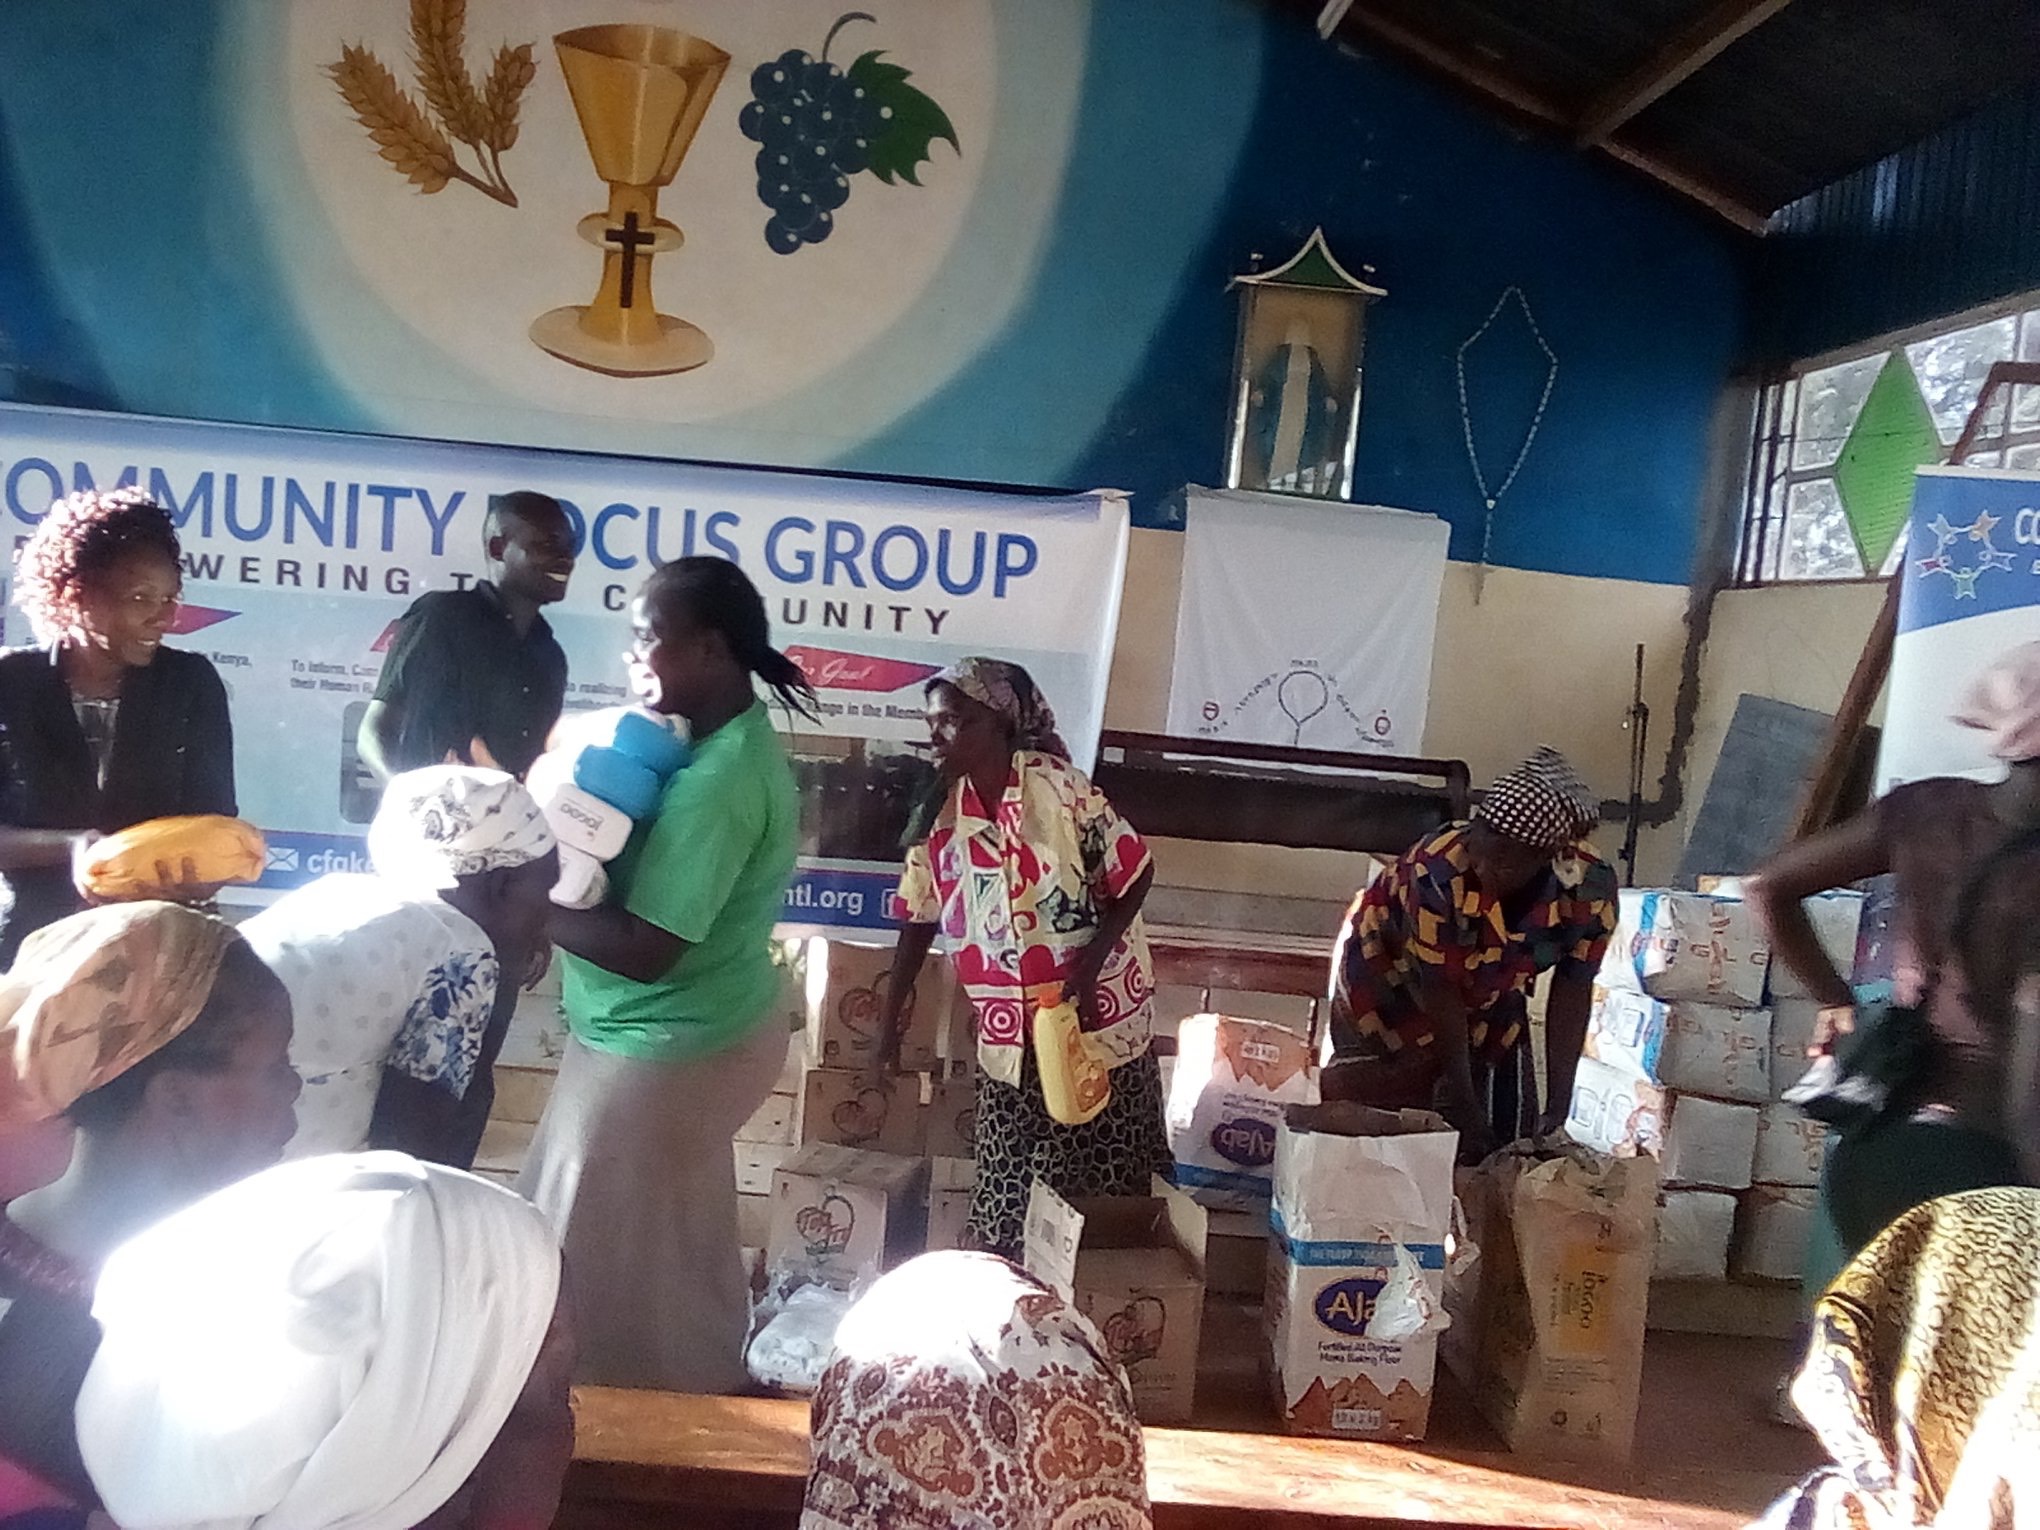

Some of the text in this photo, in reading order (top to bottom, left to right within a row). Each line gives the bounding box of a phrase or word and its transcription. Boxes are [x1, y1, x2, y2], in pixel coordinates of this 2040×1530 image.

[3, 457, 1038, 598] OMUNITY CUS GROUP
